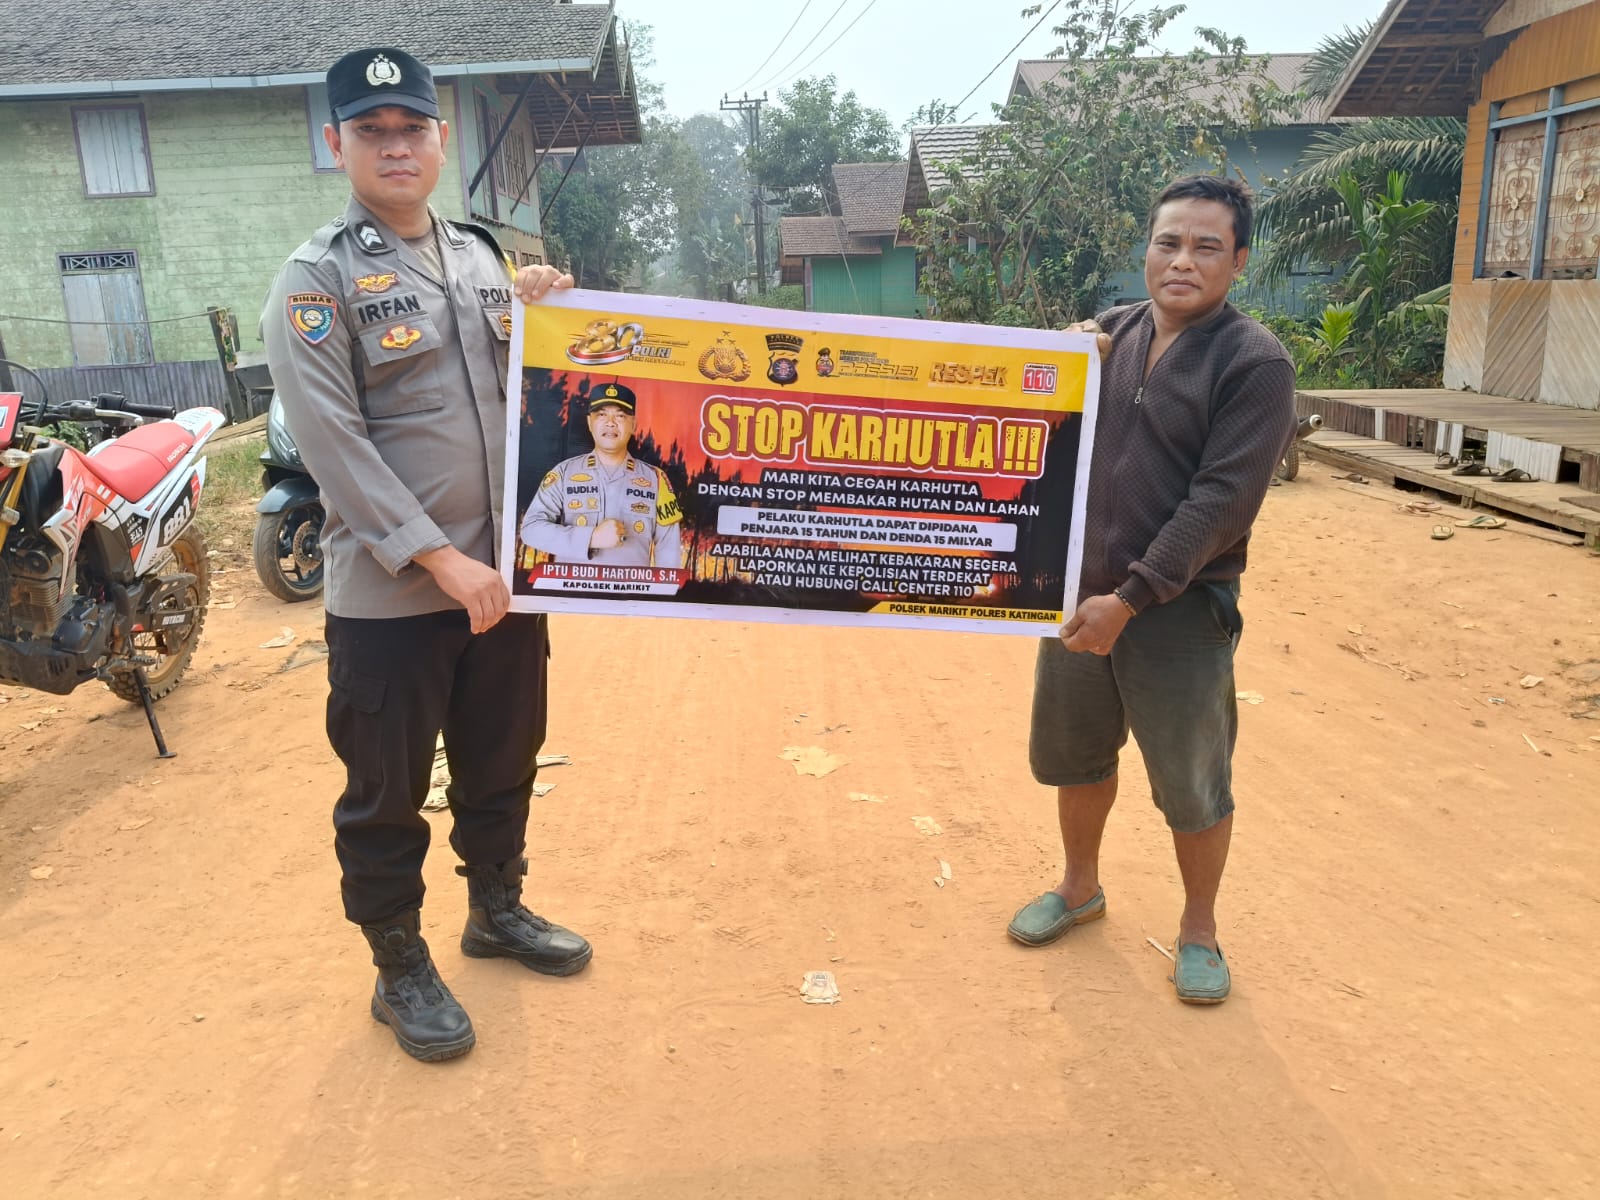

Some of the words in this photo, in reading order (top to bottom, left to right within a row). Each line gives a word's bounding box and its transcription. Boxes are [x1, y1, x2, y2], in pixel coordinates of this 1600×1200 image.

[480, 288, 511, 303] POL
[358, 295, 420, 324] IRFAN
[631, 345, 672, 358] POLRI
[929, 361, 1008, 386] RESPEK
[1026, 371, 1054, 389] 110
[708, 402, 804, 455] STOP
[811, 412, 994, 469] KARHUTLA
[1002, 425, 1042, 472] !!!
[626, 488, 656, 500] POLRI
[764, 471, 804, 484] MARI
[808, 473, 841, 487] KITA
[845, 476, 896, 491] CEGAH
[900, 480, 978, 496] KARHUTLA
[698, 483, 763, 499] DENGAN
[766, 488, 806, 501] STOP
[809, 491, 896, 507] MEMBAKAR
[901, 497, 951, 510] HUTAN
[955, 501, 985, 513] DAN
[990, 503, 1040, 516] LAHAN
[758, 511, 805, 523] PELAKU
[808, 515, 873, 527] KARHUTLA
[876, 519, 916, 530] DAPAT
[918, 522, 978, 534] DIPIDANA
[741, 523, 799, 536] PENJARA
[801, 527, 813, 536] 15
[815, 528, 858, 539] TAHUN
[860, 530, 887, 541] DAN
[889, 533, 932, 544] DENDA
[934, 535, 945, 544] 15
[947, 537, 993, 547] MILYAR
[712, 543, 771, 557] APABILA
[774, 548, 814, 561] ANDA
[818, 550, 877, 564] MELIHAT
[879, 554, 962, 569] KEBAKARAN
[965, 558, 1017, 573] SEGERA
[543, 564, 568, 577] IPTU
[572, 566, 598, 578] BUDI
[602, 568, 656, 582] HARTONO,
[659, 570, 680, 582] S.H.
[740, 559, 816, 574] LAPORKAN
[819, 564, 836, 575] KE
[839, 565, 919, 580] KEPOLISIAN
[922, 570, 991, 584] TERDEKAT
[562, 581, 611, 590] KAPOLSEK
[613, 584, 651, 592] MARIKIT
[755, 573, 792, 586] ATAU
[795, 577, 858, 591] HUBUNGI
[861, 580, 896, 592] CALL
[898, 582, 950, 596] CENTER
[953, 586, 973, 597] 110
[889, 603, 926, 613] POLSEK
[928, 606, 968, 616] MARIKIT
[970, 608, 1006, 618] POLRES
[1008, 611, 1057, 621] KATINGAN
